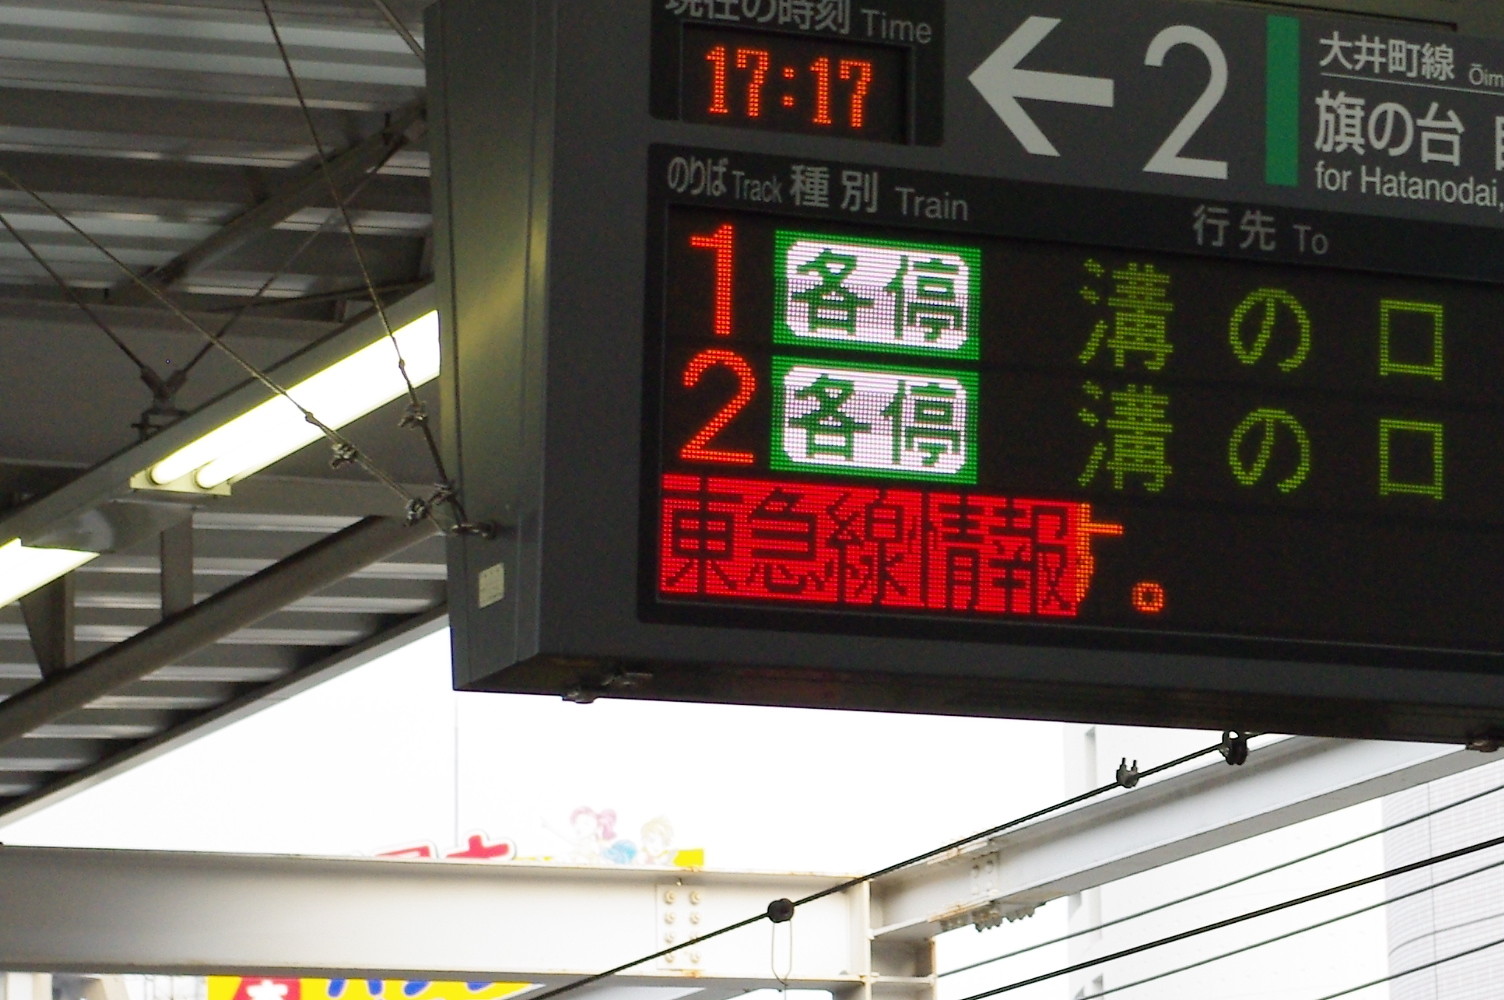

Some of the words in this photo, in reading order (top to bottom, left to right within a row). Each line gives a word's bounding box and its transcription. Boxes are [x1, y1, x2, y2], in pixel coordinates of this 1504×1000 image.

[860, 8, 933, 45] Time
[1319, 30, 1456, 82] 大井町線
[705, 45, 873, 129] 17:17
[1142, 24, 1229, 180] 2
[1314, 90, 1465, 168] 旗の台
[667, 156, 726, 195] のりば
[731, 171, 784, 205] Track
[789, 163, 879, 214] 種別
[893, 186, 969, 222] Train
[1315, 161, 1352, 192] for
[1360, 165, 1504, 213] Hatanodai,
[1192, 205, 1277, 251] 行先
[1293, 224, 1330, 256] To
[689, 224, 736, 337] 1
[788, 245, 970, 344] 各停
[679, 349, 757, 465] 2
[786, 370, 968, 470] 各停
[660, 478, 1077, 616] 東急線情報
